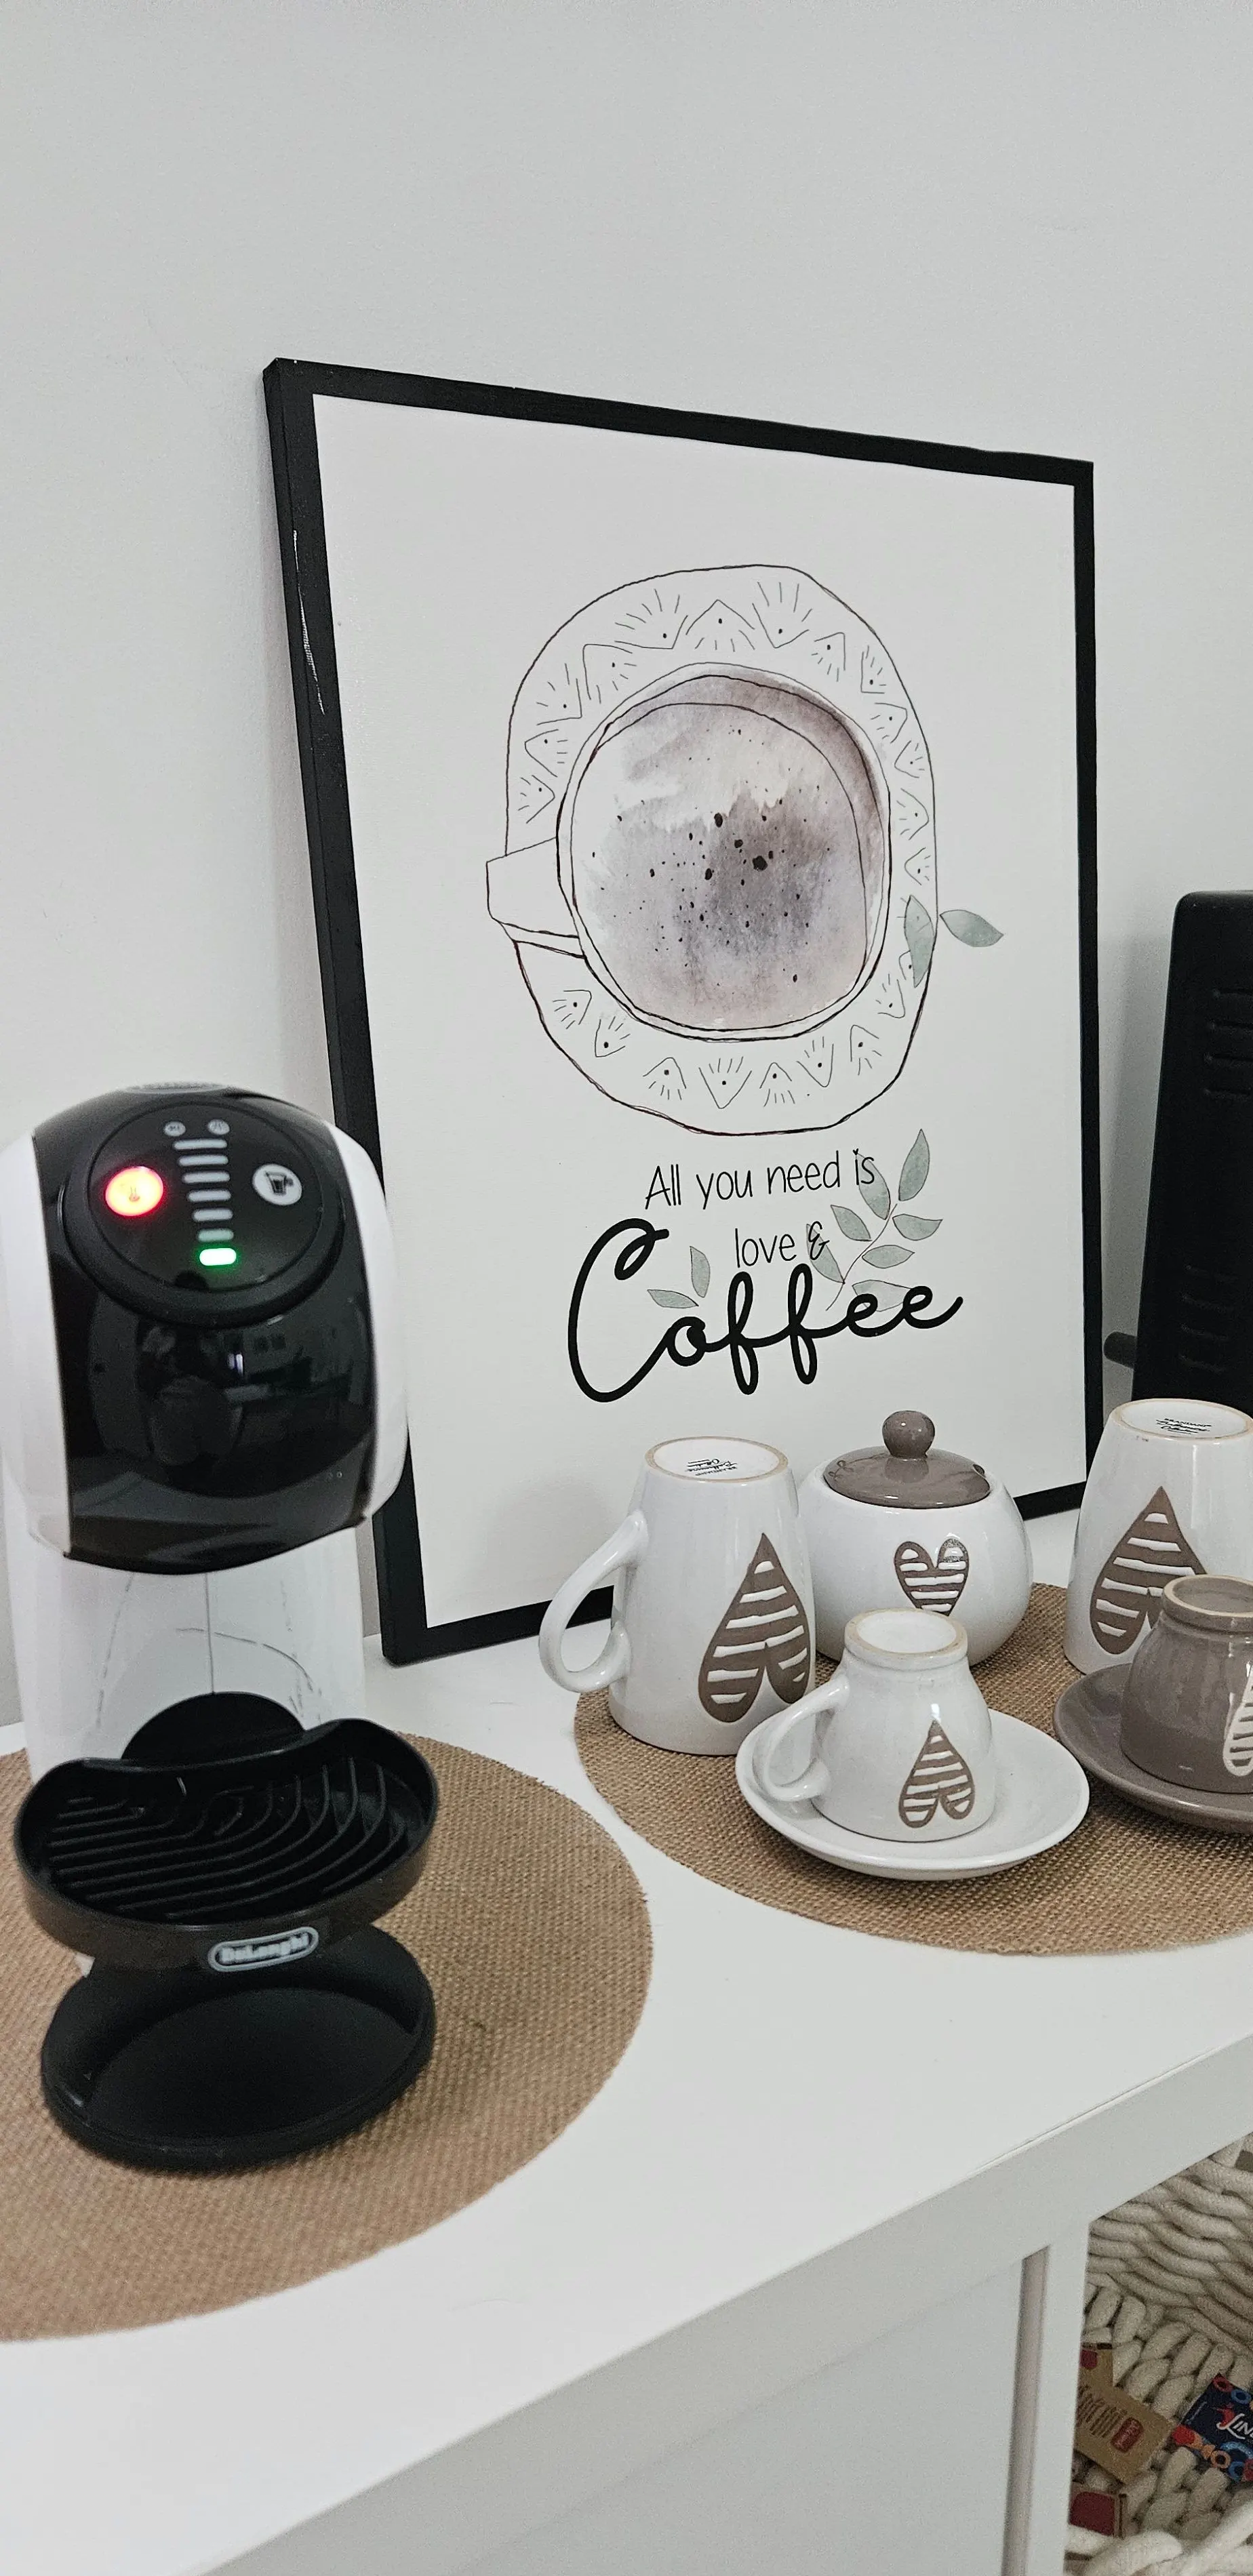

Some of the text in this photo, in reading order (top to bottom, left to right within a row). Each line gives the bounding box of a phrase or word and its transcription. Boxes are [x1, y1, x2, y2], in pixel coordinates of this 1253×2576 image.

[645, 1148, 875, 1210] All you need is
[734, 1222, 830, 1268] love &
[568, 1217, 963, 1403] Coffee
